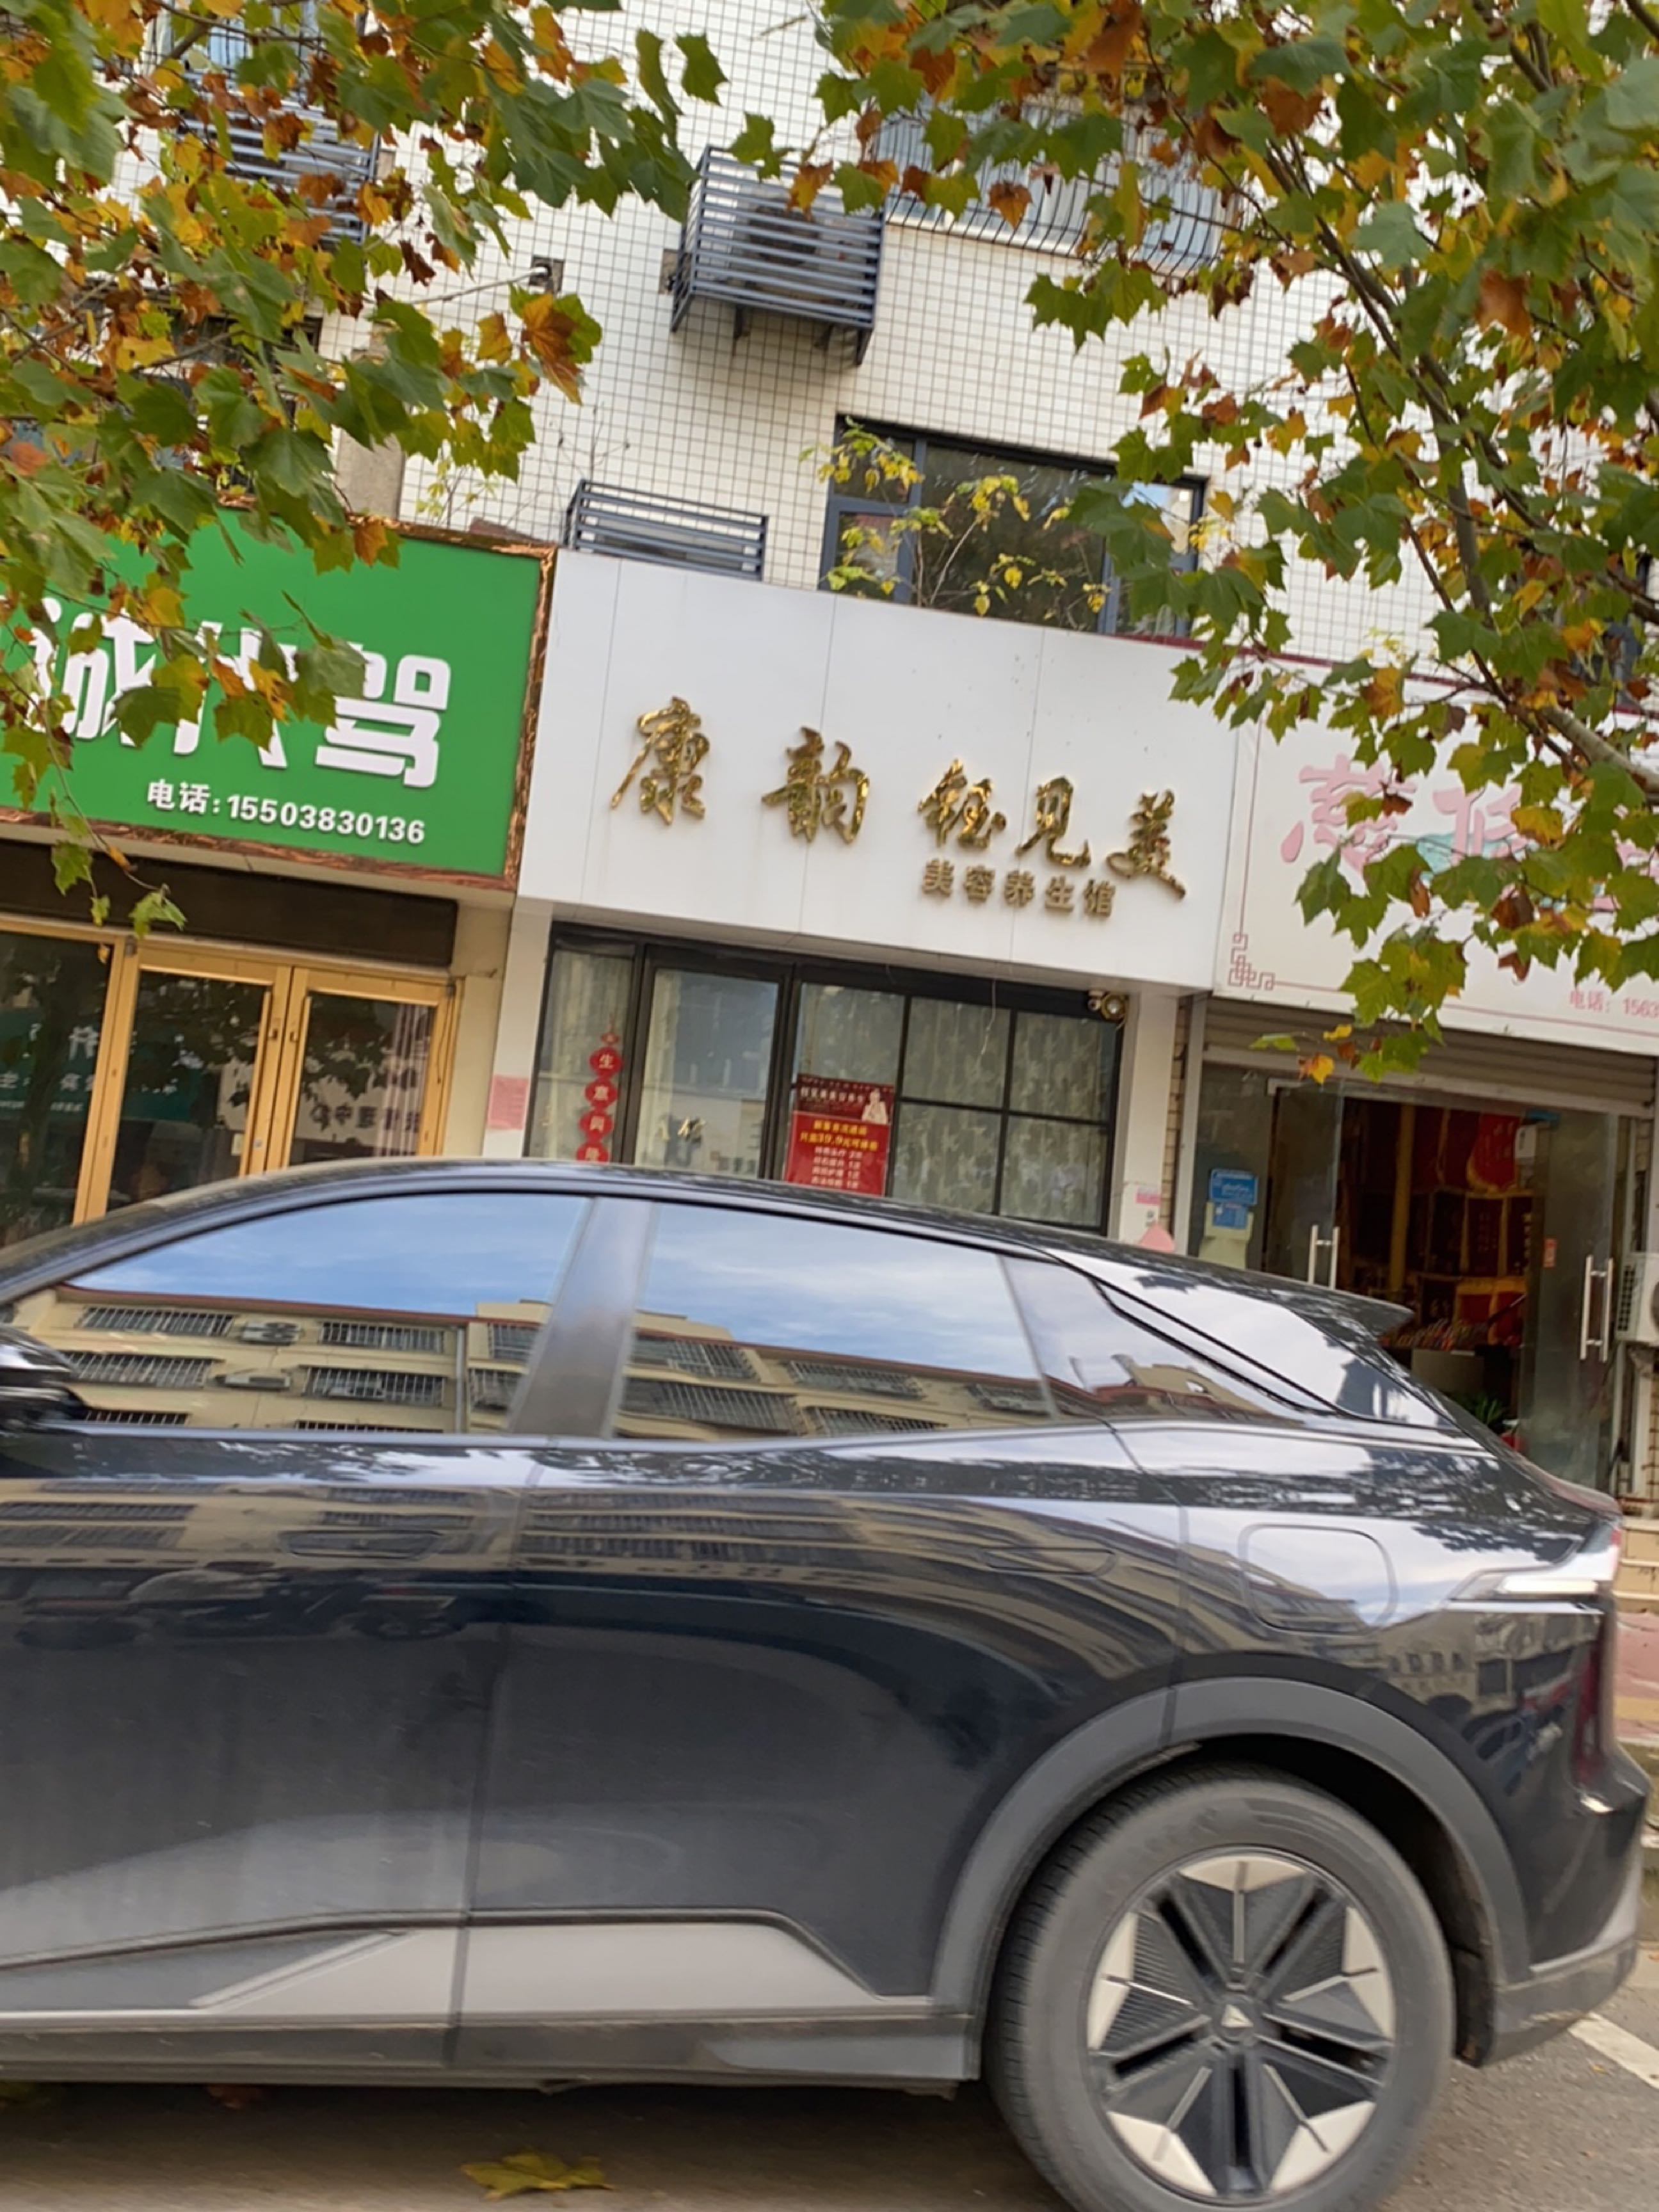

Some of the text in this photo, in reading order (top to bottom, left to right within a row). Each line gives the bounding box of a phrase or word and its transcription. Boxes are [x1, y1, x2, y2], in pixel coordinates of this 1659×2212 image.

[921, 856, 1117, 918] 美容养生馆
